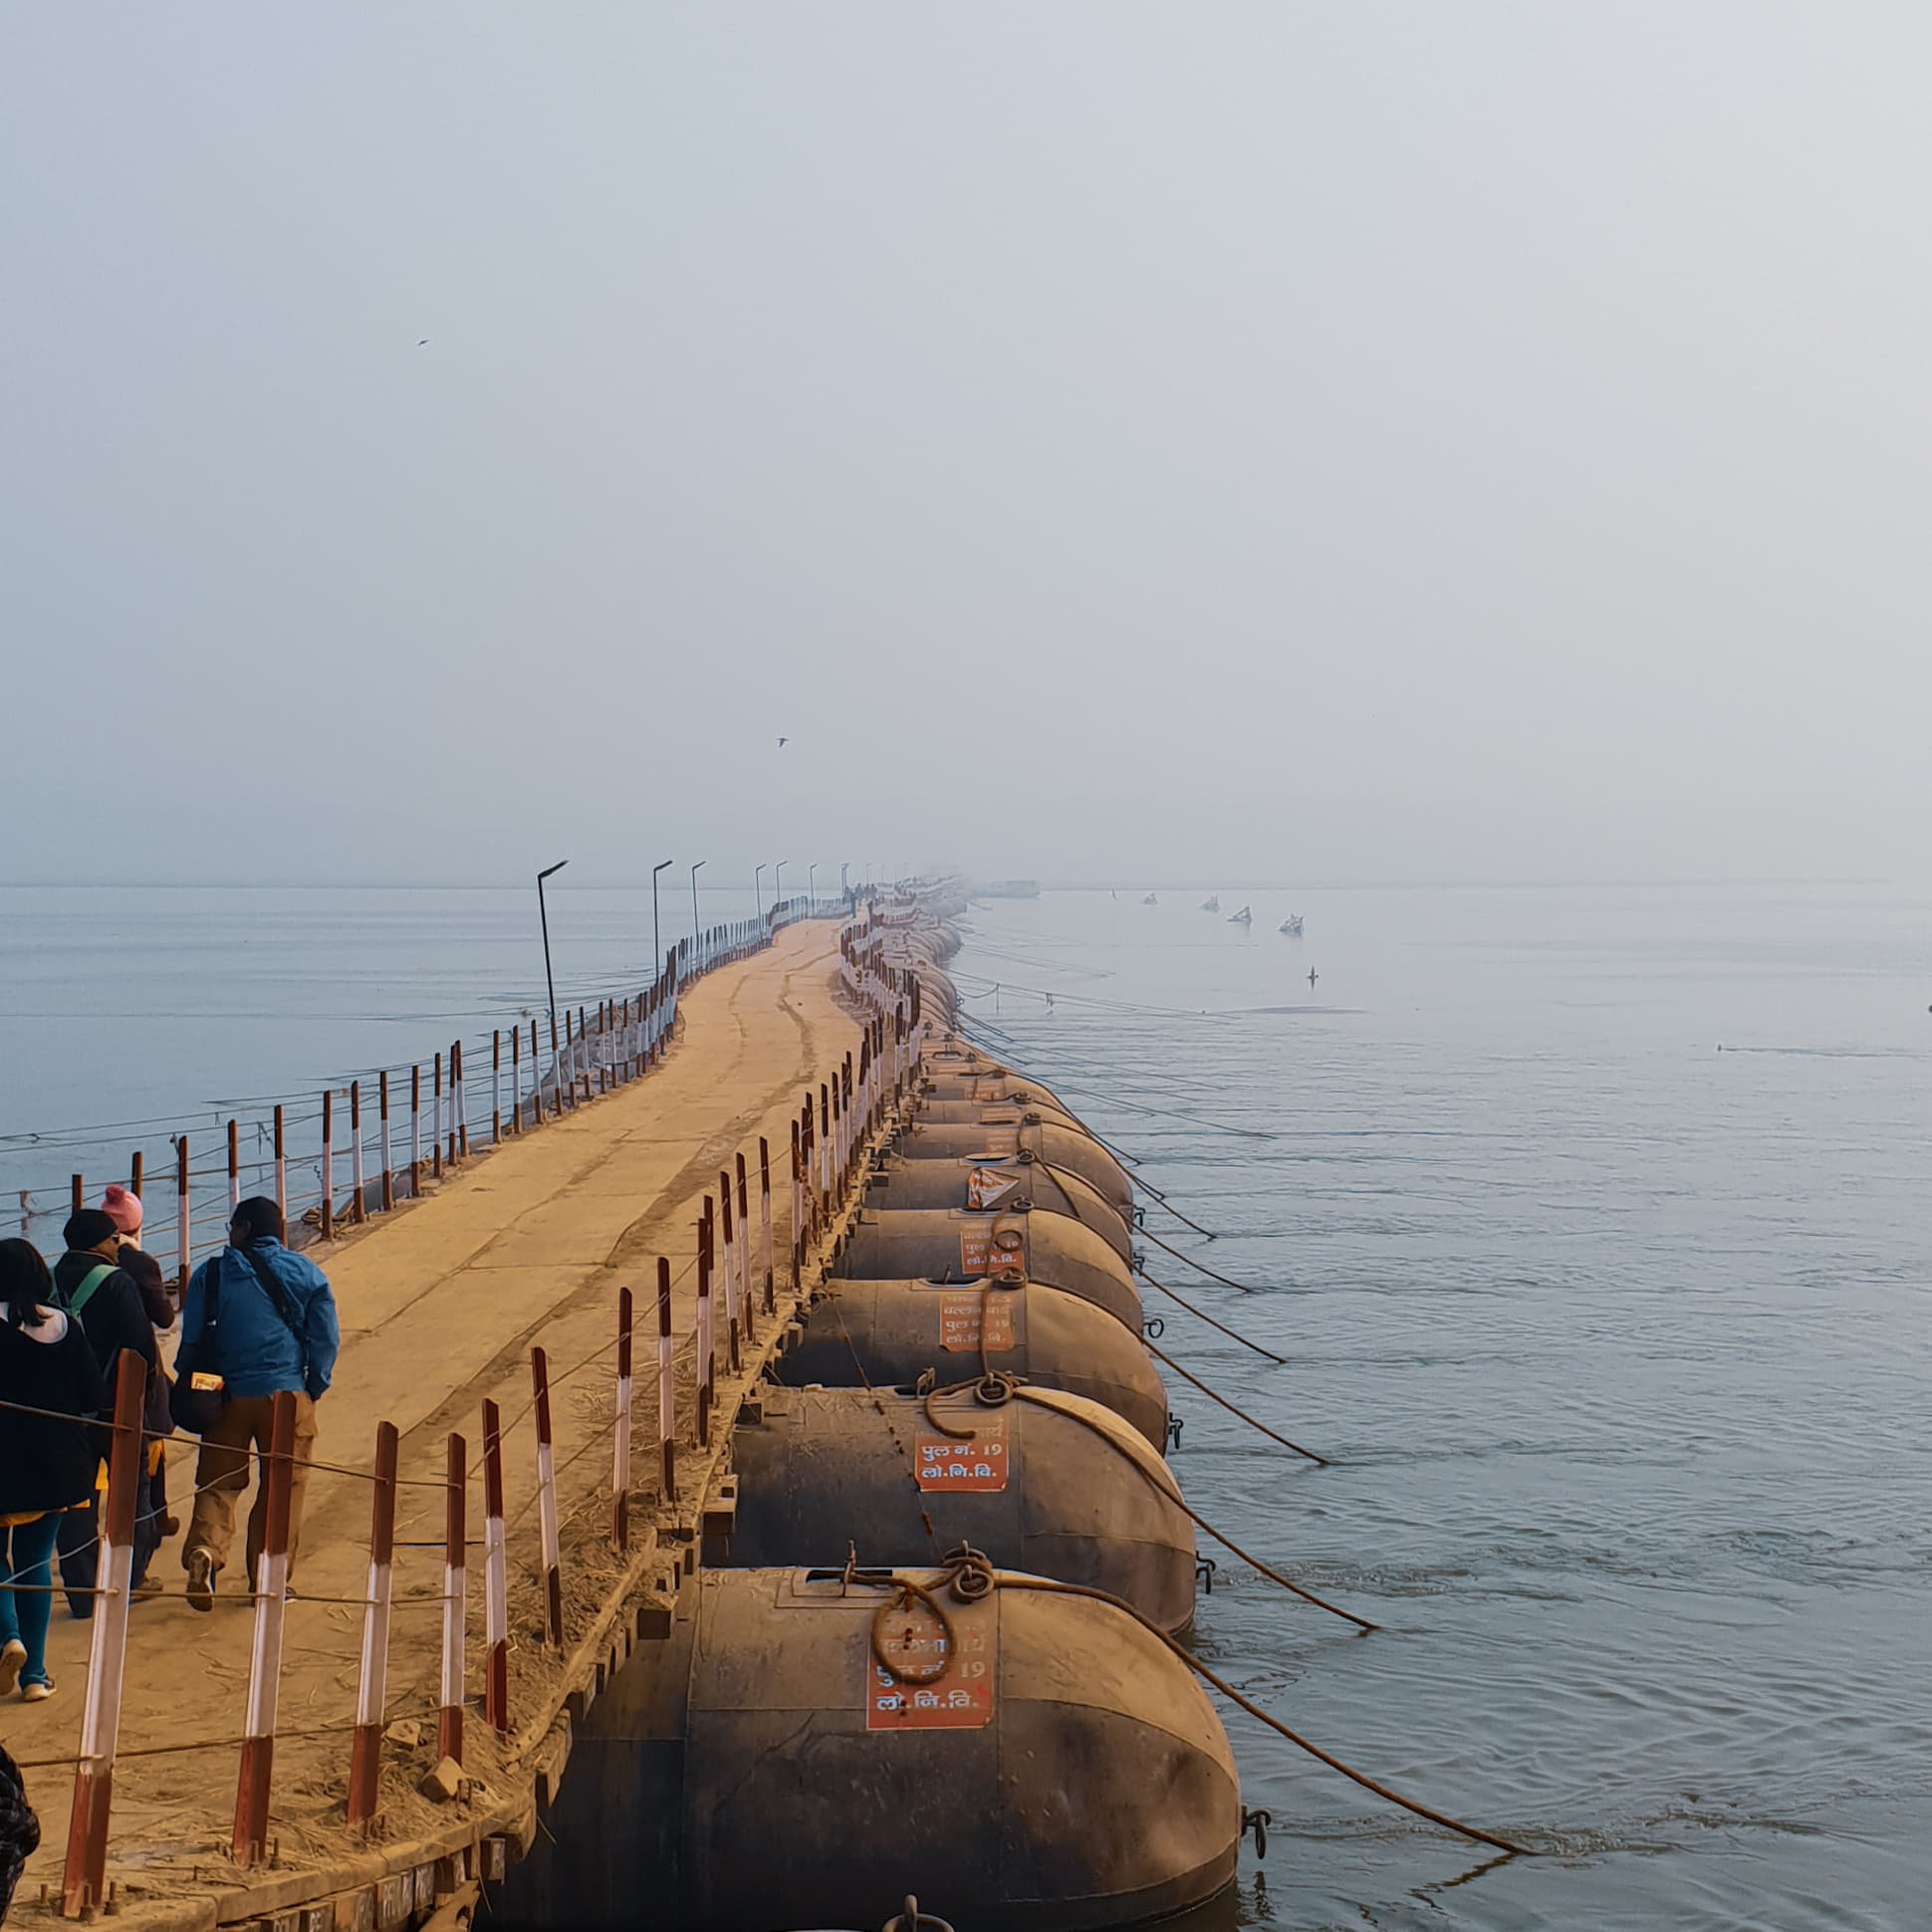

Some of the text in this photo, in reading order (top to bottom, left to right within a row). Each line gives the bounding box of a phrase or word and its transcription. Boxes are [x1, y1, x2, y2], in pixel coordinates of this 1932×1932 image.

[946, 1321, 968, 1332] पुल
[947, 1332, 1006, 1343] लो.निवि.
[921, 1443, 1003, 1462] पुल नं. 19
[921, 1463, 997, 1478] लो.नि.वि.
[959, 1660, 986, 1679] 19
[876, 1689, 979, 1712] लो.नि.वि.
